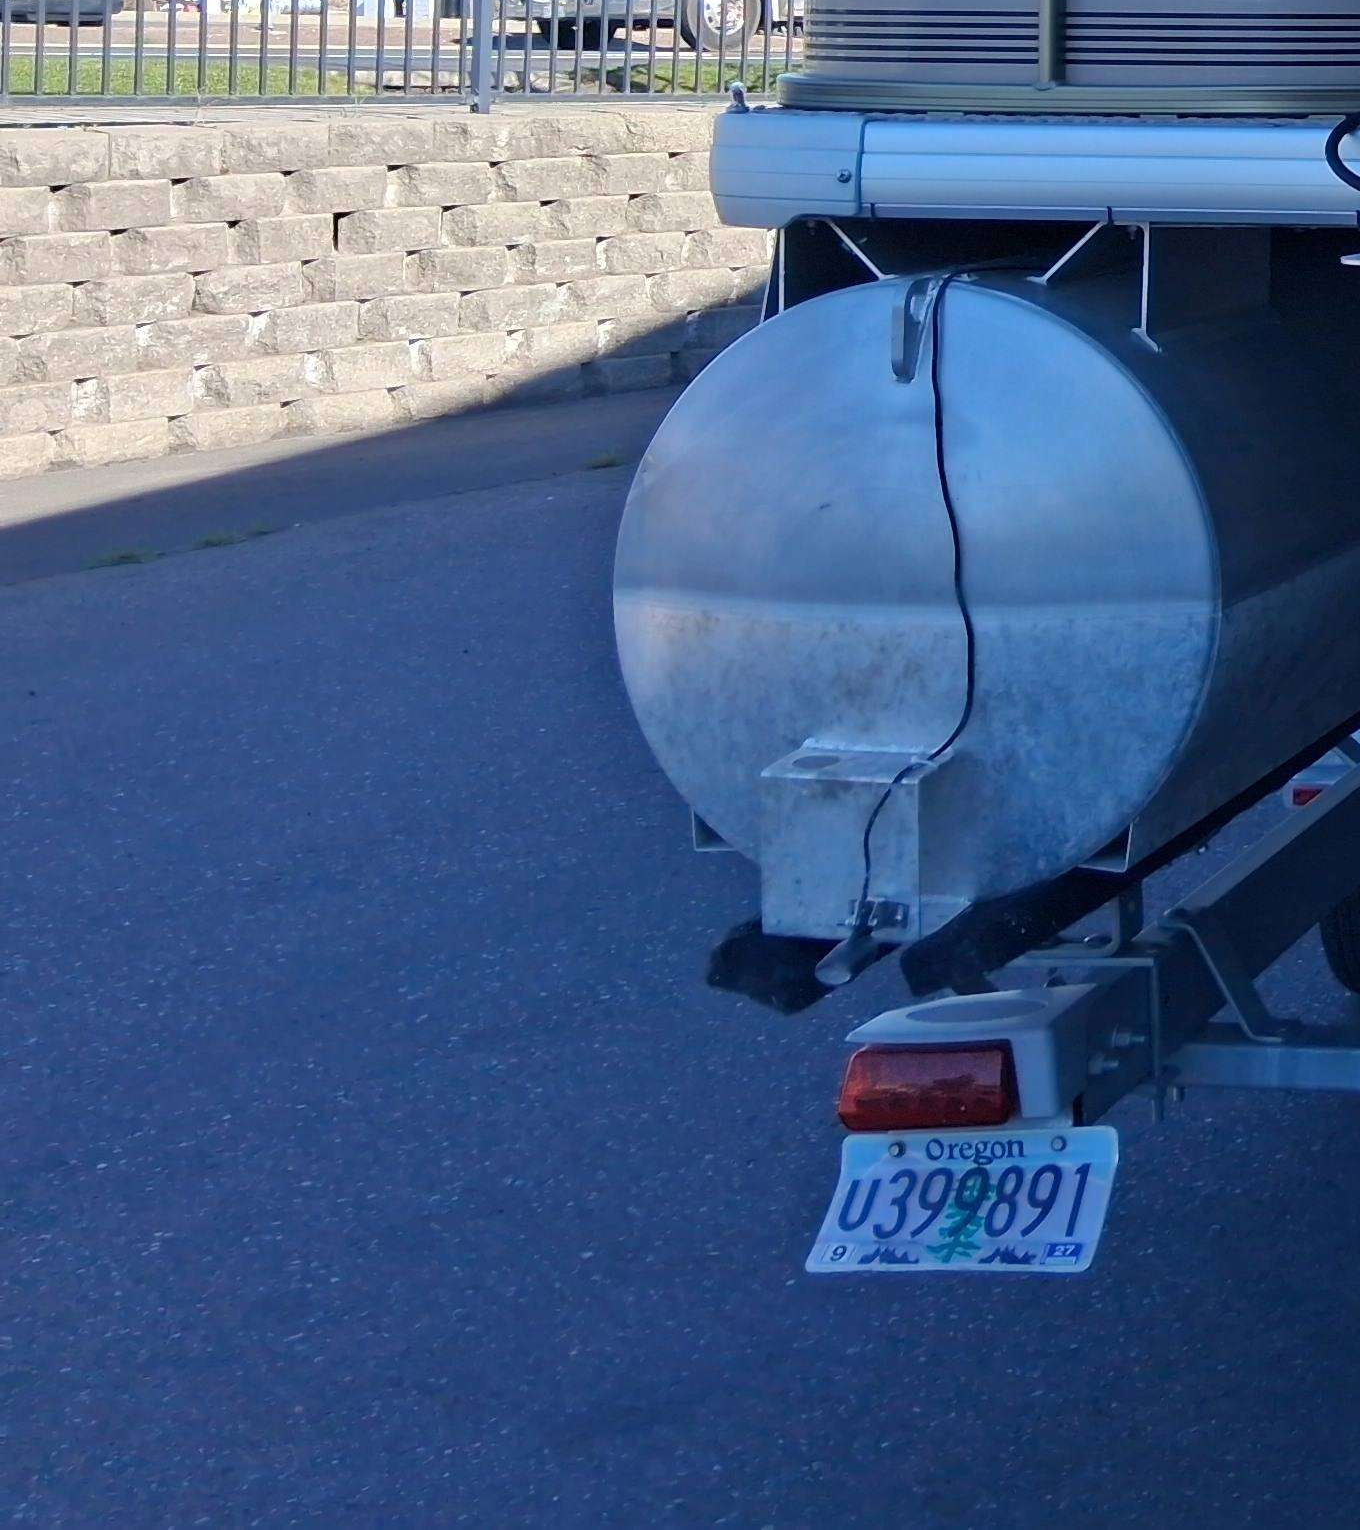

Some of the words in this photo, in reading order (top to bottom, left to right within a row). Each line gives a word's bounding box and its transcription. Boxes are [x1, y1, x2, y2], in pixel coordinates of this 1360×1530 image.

[926, 1138, 1025, 1165] Oregon
[838, 1163, 1091, 1240] U399891
[831, 1245, 848, 1261] 9
[1053, 1244, 1077, 1257] 27
